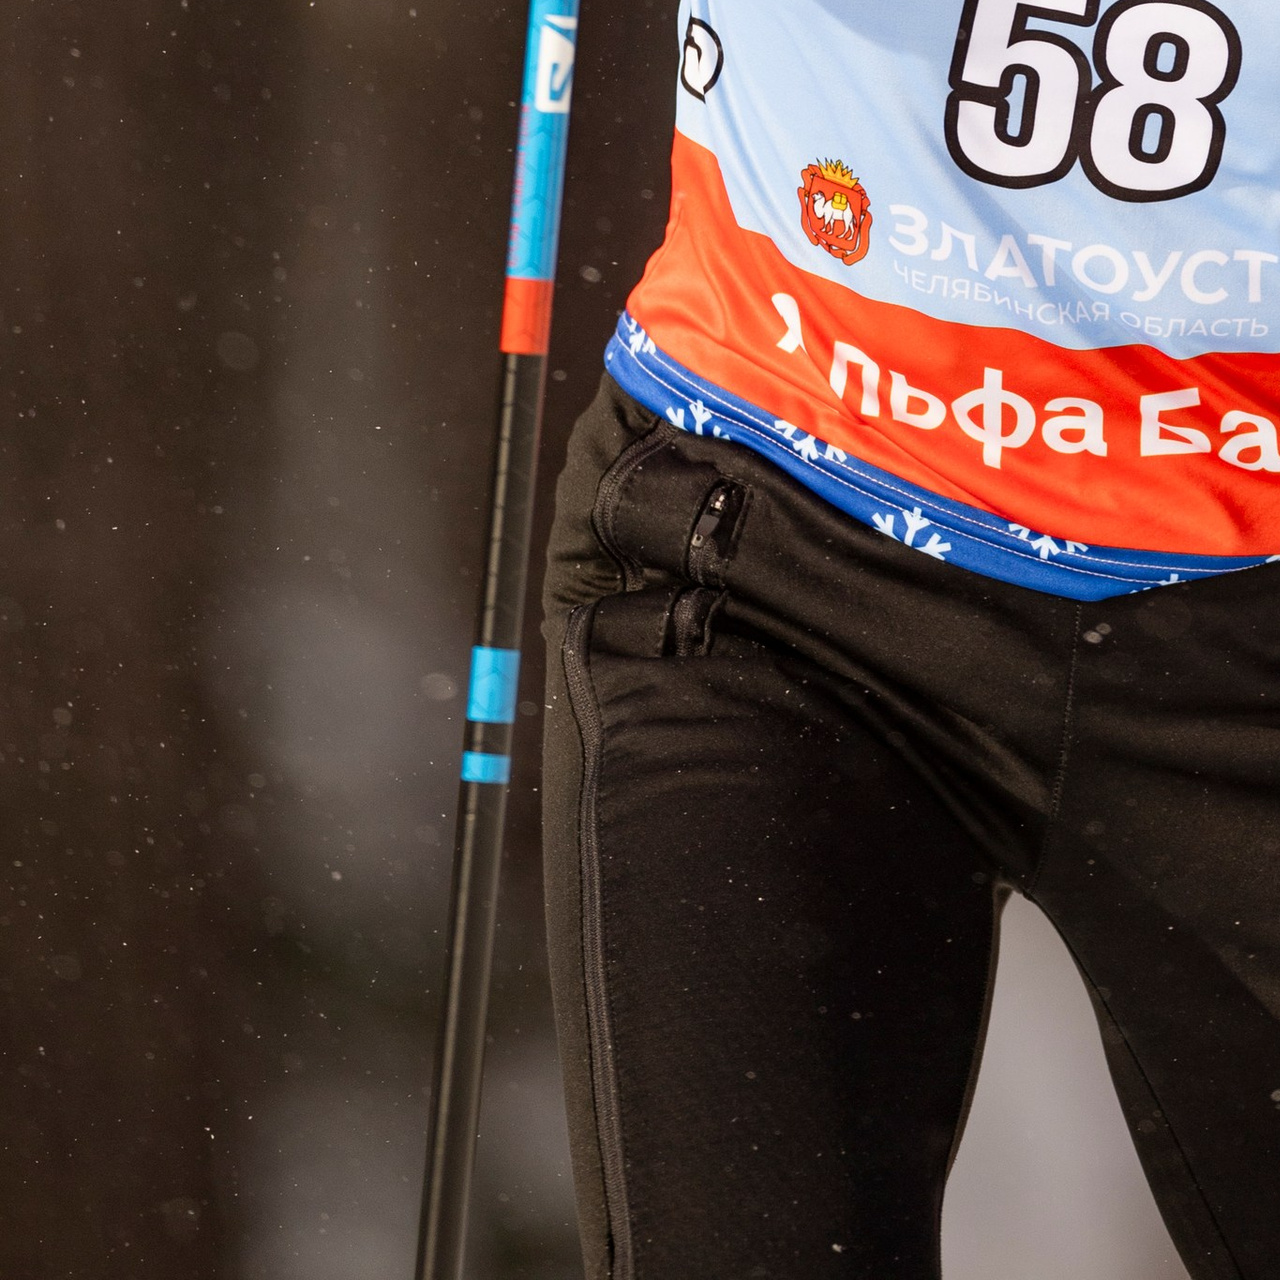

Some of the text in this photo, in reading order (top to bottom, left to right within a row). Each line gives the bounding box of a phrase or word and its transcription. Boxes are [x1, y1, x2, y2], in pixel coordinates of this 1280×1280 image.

[887, 203, 1279, 305] ЗЛАТОУСТ
[893, 259, 1270, 338] ЧЕЛЯБИНСКАЯ ОБЛАСТЬ
